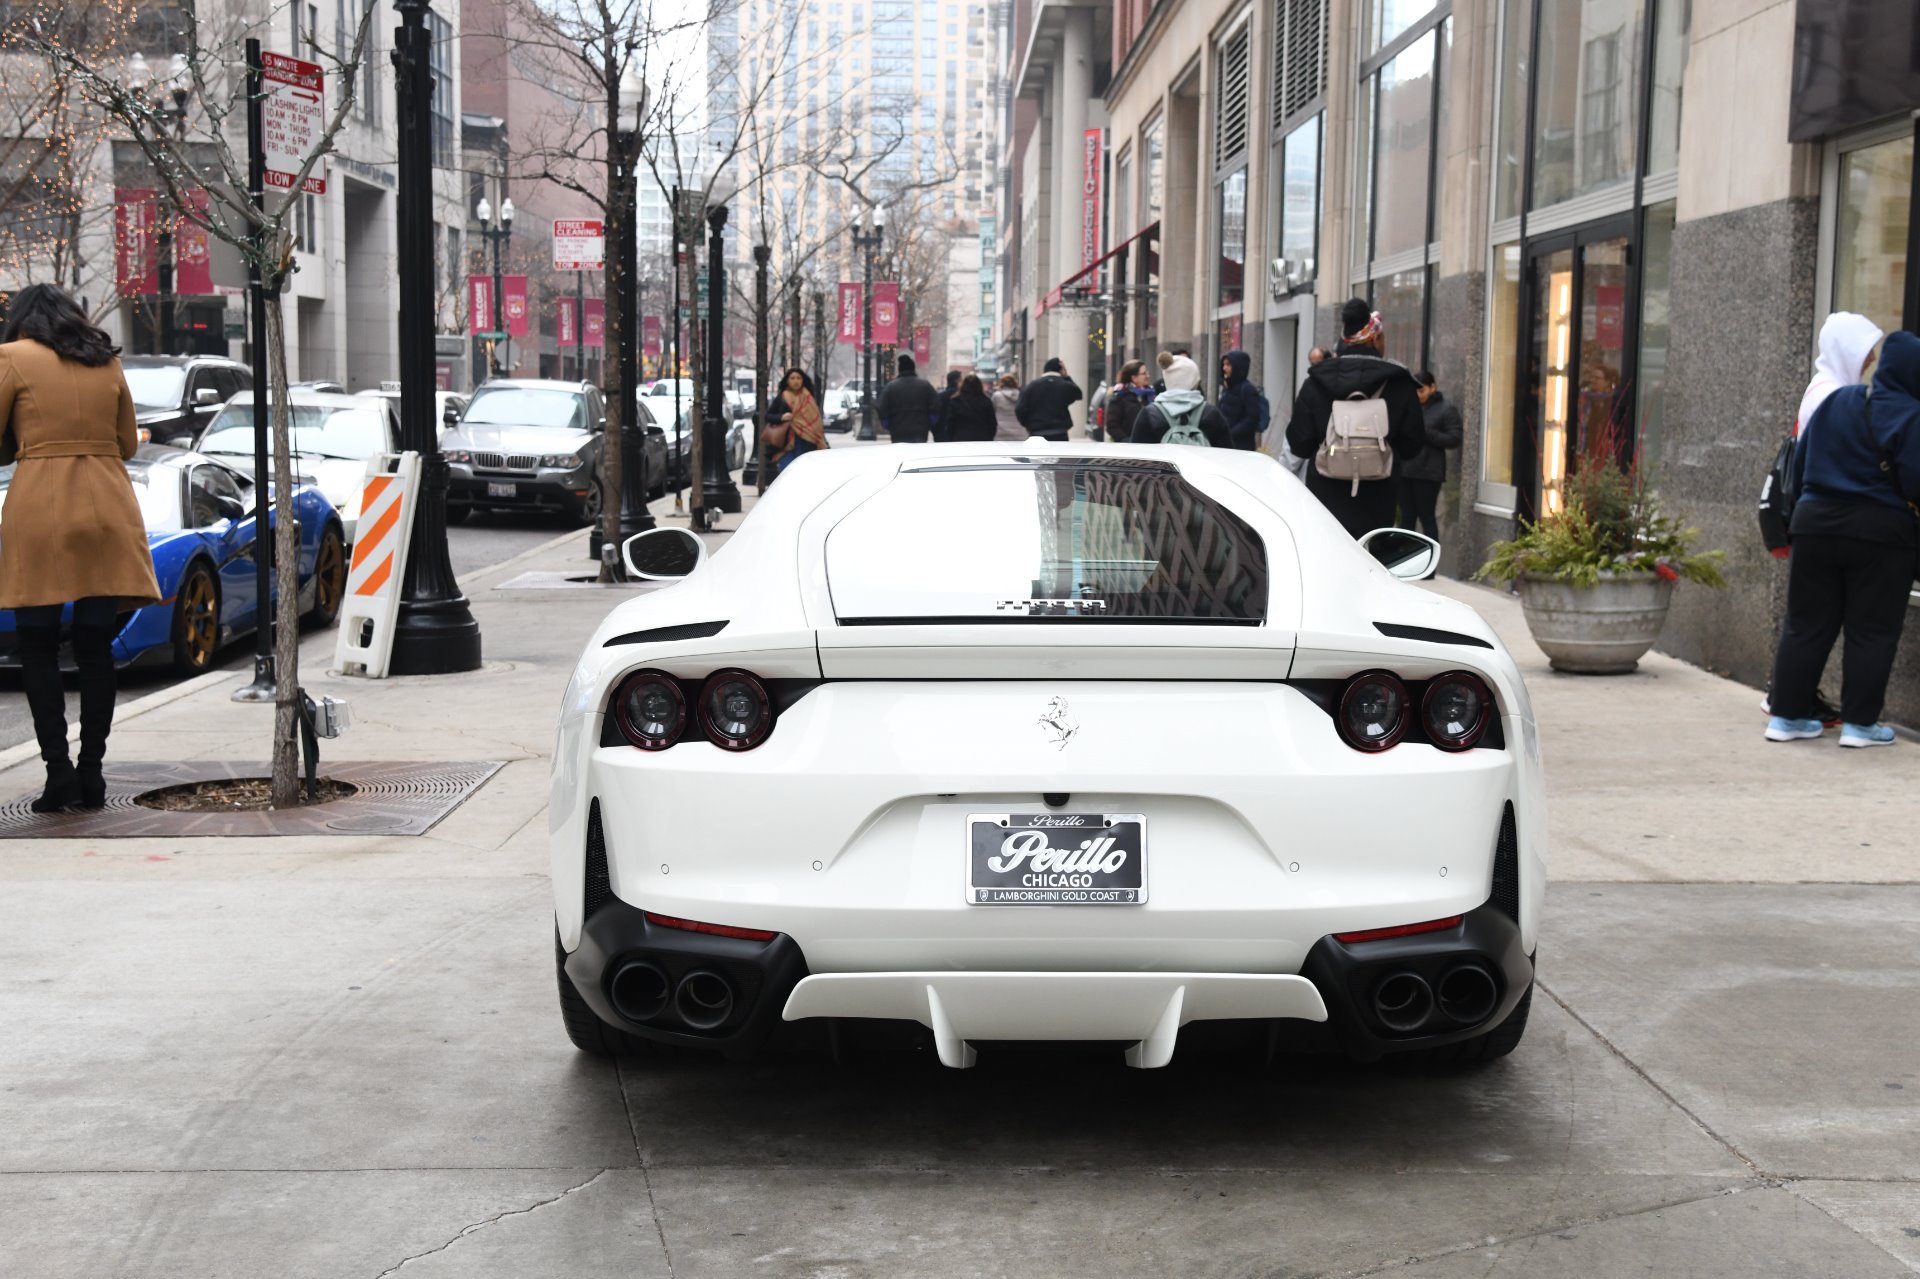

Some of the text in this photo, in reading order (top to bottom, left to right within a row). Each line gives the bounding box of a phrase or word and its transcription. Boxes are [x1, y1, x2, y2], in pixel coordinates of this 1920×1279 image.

[265, 55, 298, 72] 15 MINUTE
[265, 84, 279, 96] USE
[266, 97, 321, 118] FLASHING LIGHTS
[266, 107, 274, 117] 10
[275, 110, 285, 119] AM
[292, 113, 296, 122] 8
[298, 114, 308, 124] PM
[266, 119, 281, 129] MON
[289, 123, 311, 137] THURS
[267, 130, 274, 140] 10
[275, 132, 285, 142] AM
[292, 136, 297, 145] 6
[298, 137, 308, 146] PM
[267, 141, 279, 152] FRI
[285, 145, 299, 155] SUN
[268, 171, 321, 192] TOW ONE
[557, 221, 585, 229] STREET
[475, 281, 484, 328] WELCOME
[561, 303, 569, 341] WELCOME
[1028, 814, 1085, 827] Perillo
[987, 830, 1127, 874] Perillo
[1022, 873, 1093, 888] CHICAGO
[994, 891, 1120, 901] LAMBORGHINI GOLD COAST
